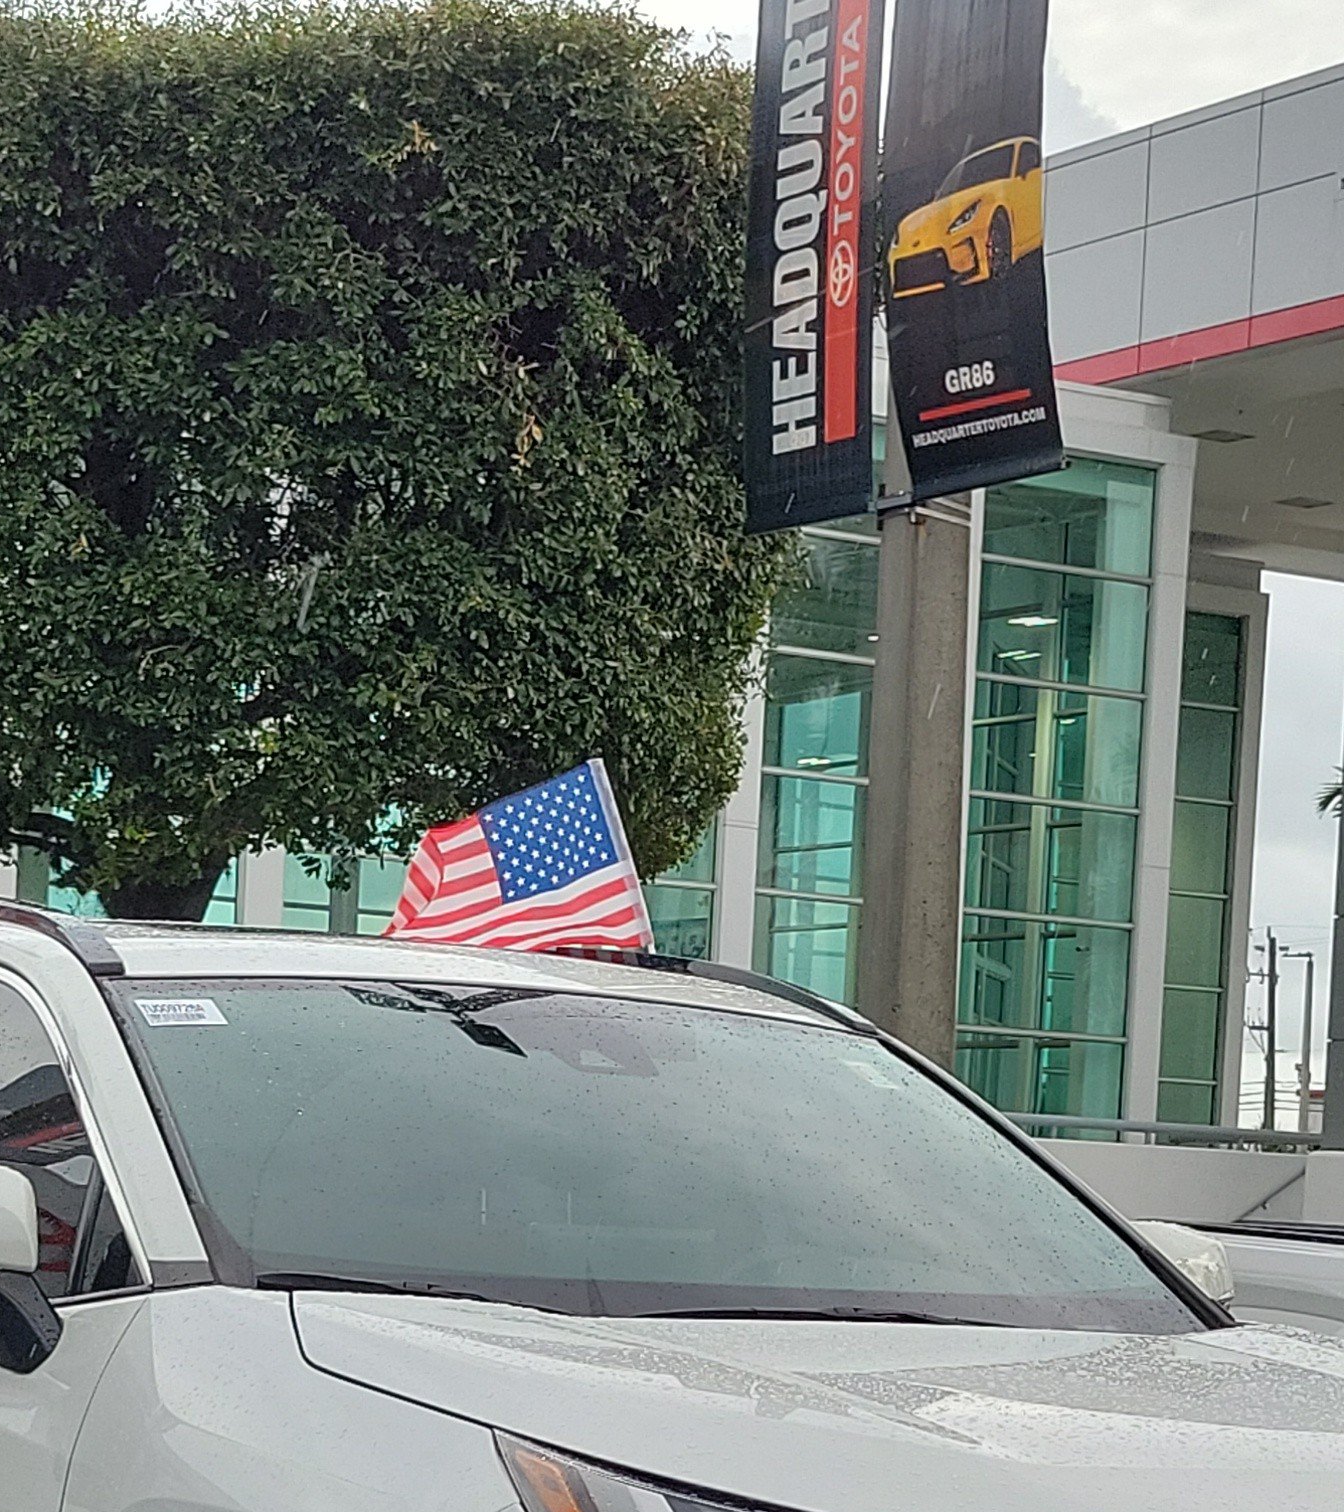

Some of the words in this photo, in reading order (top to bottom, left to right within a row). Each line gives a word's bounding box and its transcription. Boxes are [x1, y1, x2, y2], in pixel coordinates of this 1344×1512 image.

[832, 14, 863, 237] TOYOTA
[944, 360, 996, 394] GR86
[912, 406, 1047, 449] HEADQUARTERTOYOTA.COM
